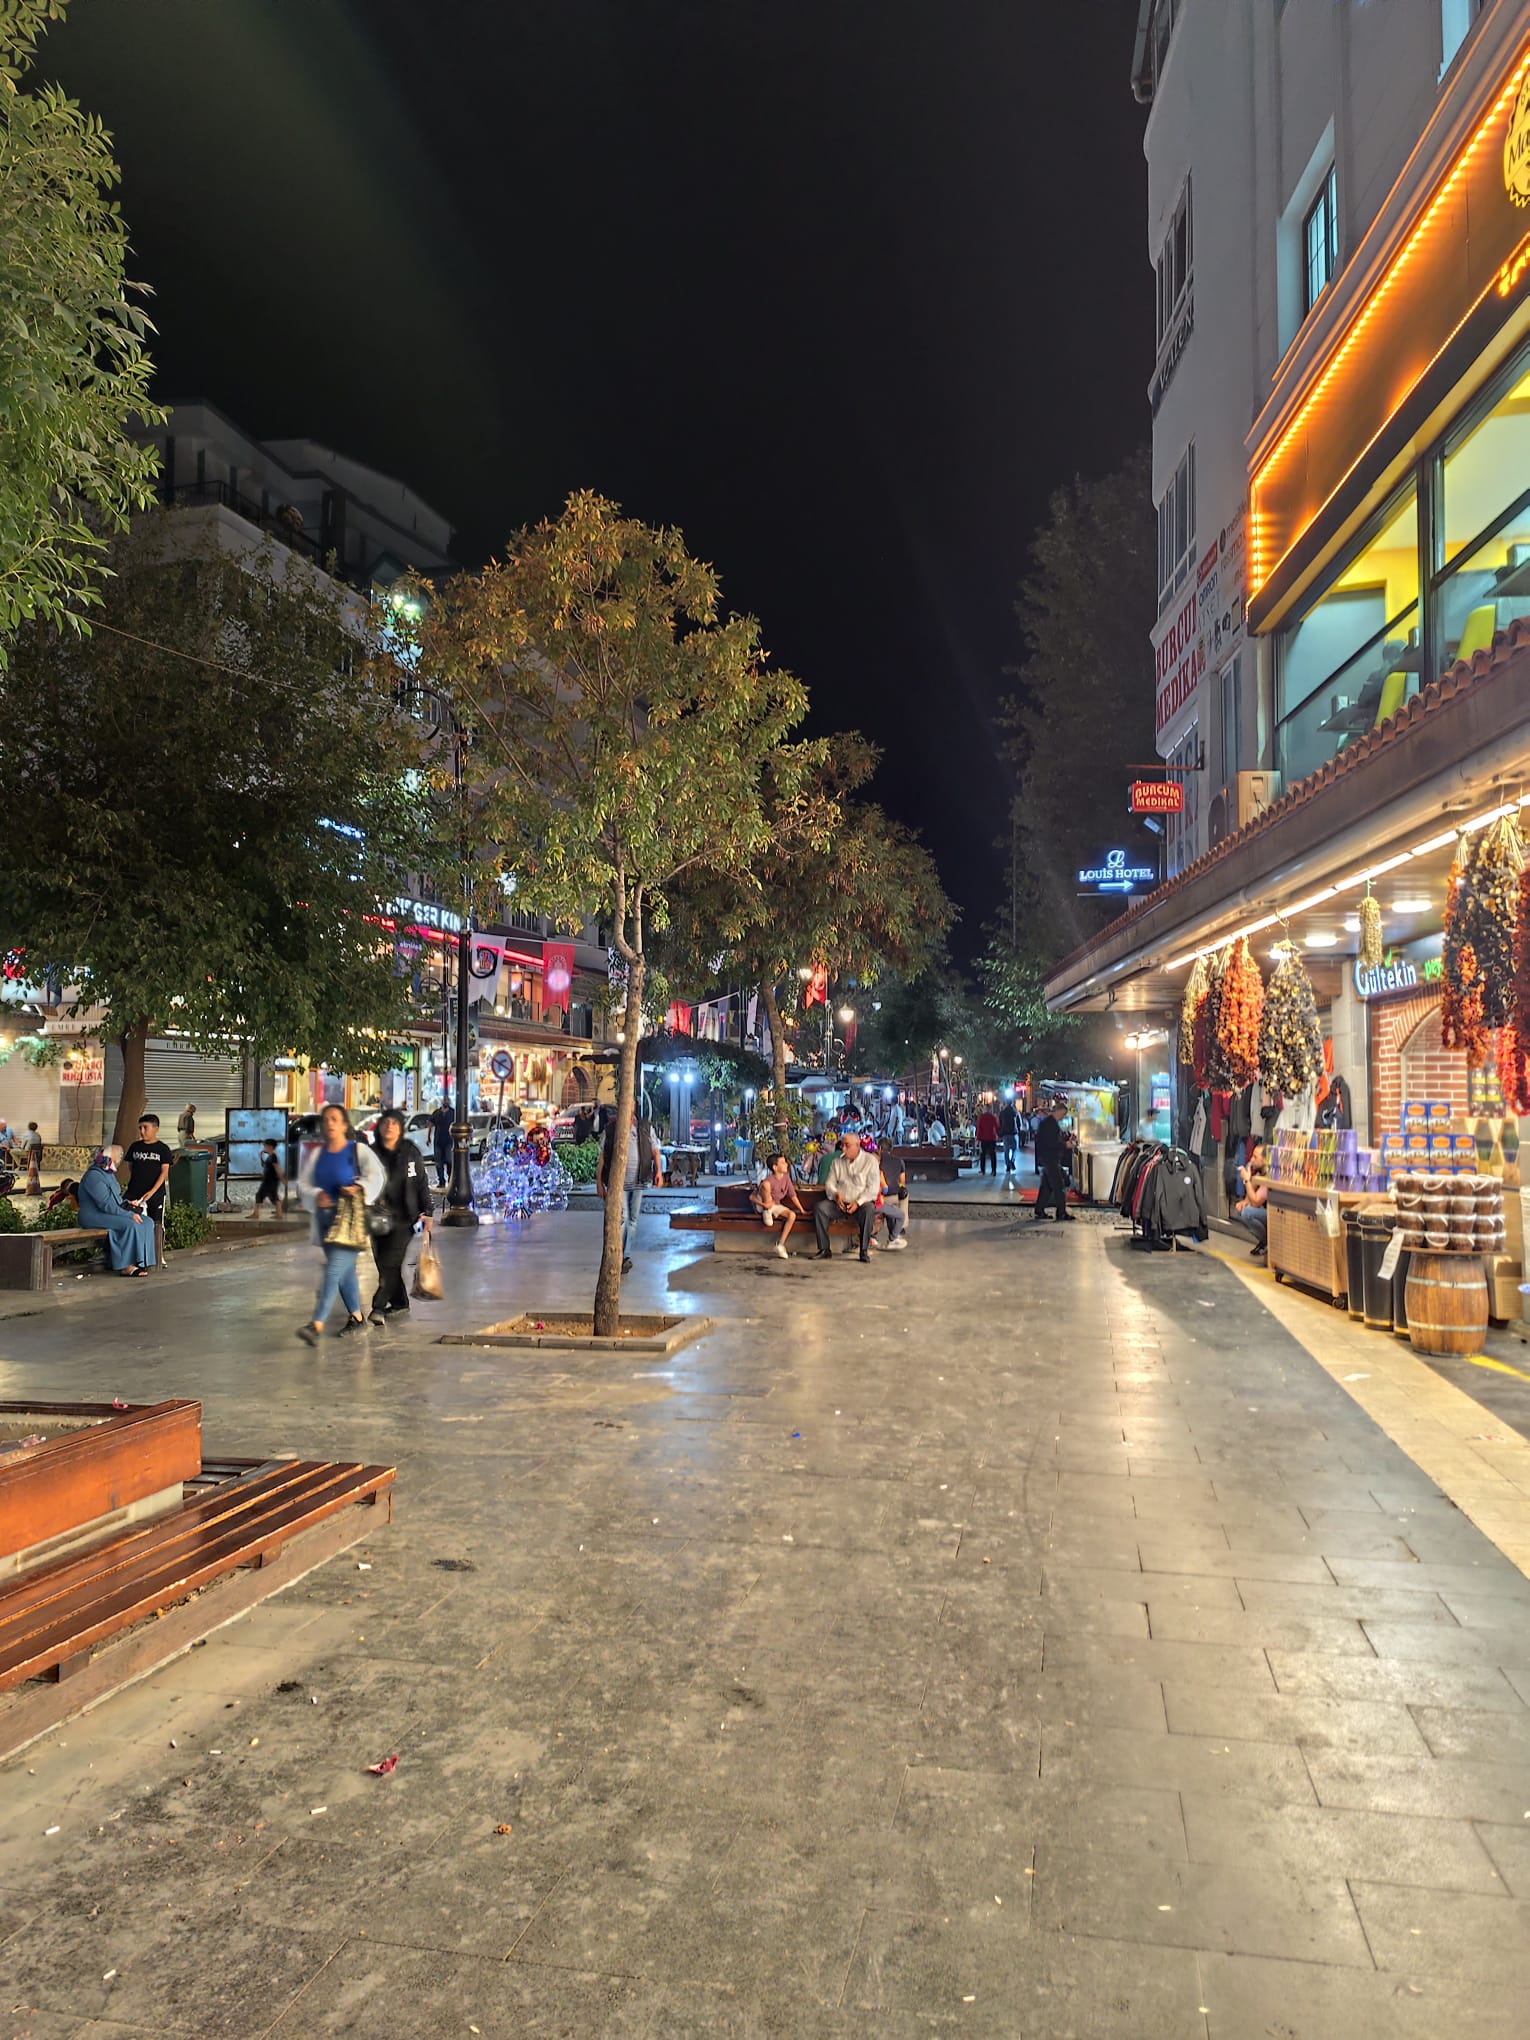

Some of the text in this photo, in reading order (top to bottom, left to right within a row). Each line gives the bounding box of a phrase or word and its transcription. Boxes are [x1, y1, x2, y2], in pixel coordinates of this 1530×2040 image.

[1135, 784, 1181, 800] BURCUM
[1115, 868, 1154, 881] HOTEL
[1354, 959, 1417, 996] Gültekin
